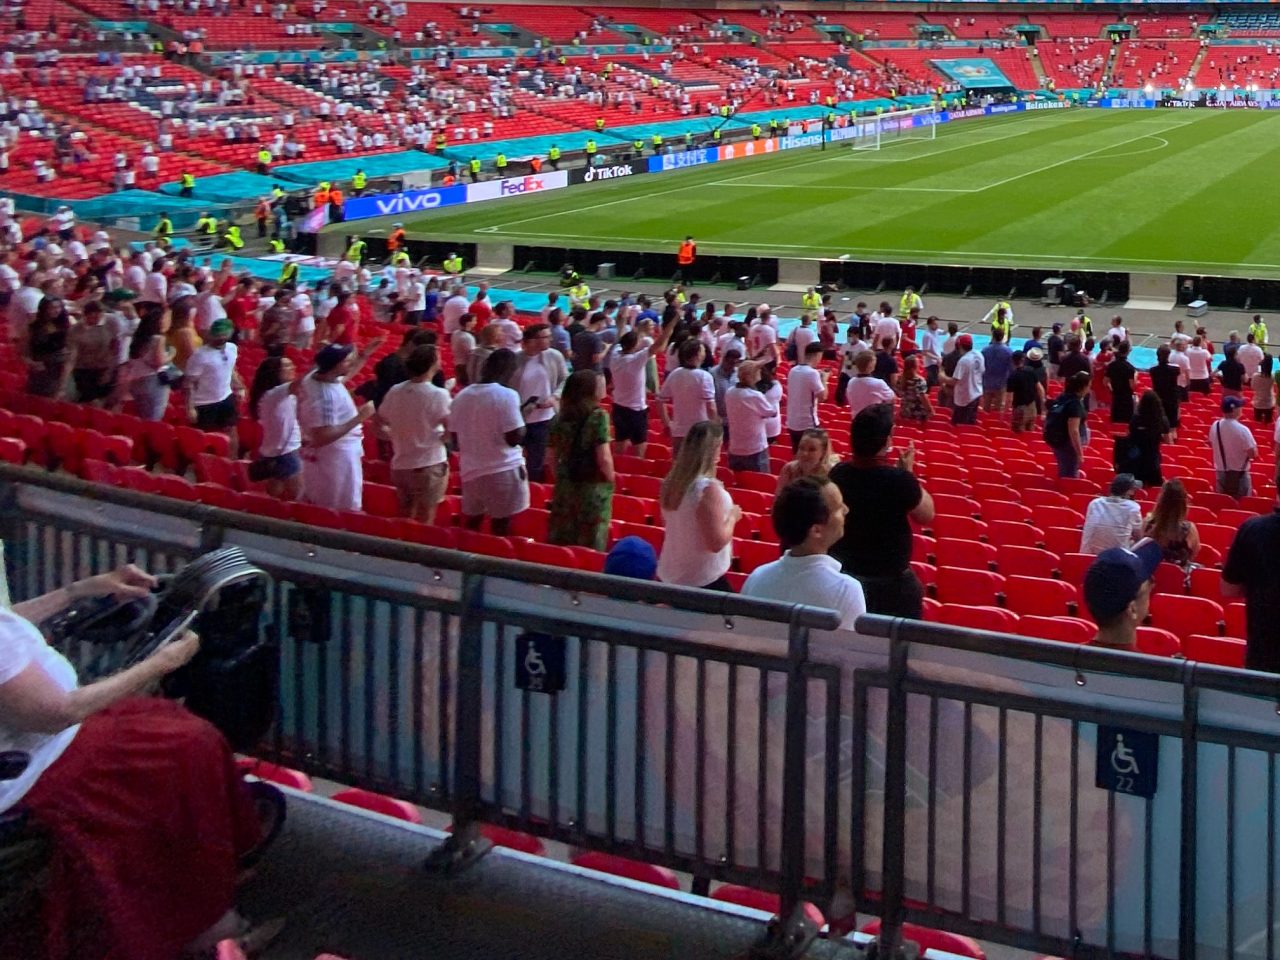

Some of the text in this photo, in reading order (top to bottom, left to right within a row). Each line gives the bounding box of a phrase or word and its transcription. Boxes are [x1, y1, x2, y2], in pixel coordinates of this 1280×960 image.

[1025, 101, 1063, 110] Heineken
[597, 164, 633, 179] TikTok
[501, 175, 545, 196] FedEx
[377, 192, 442, 214] vivo
[1115, 775, 1135, 792] 22
